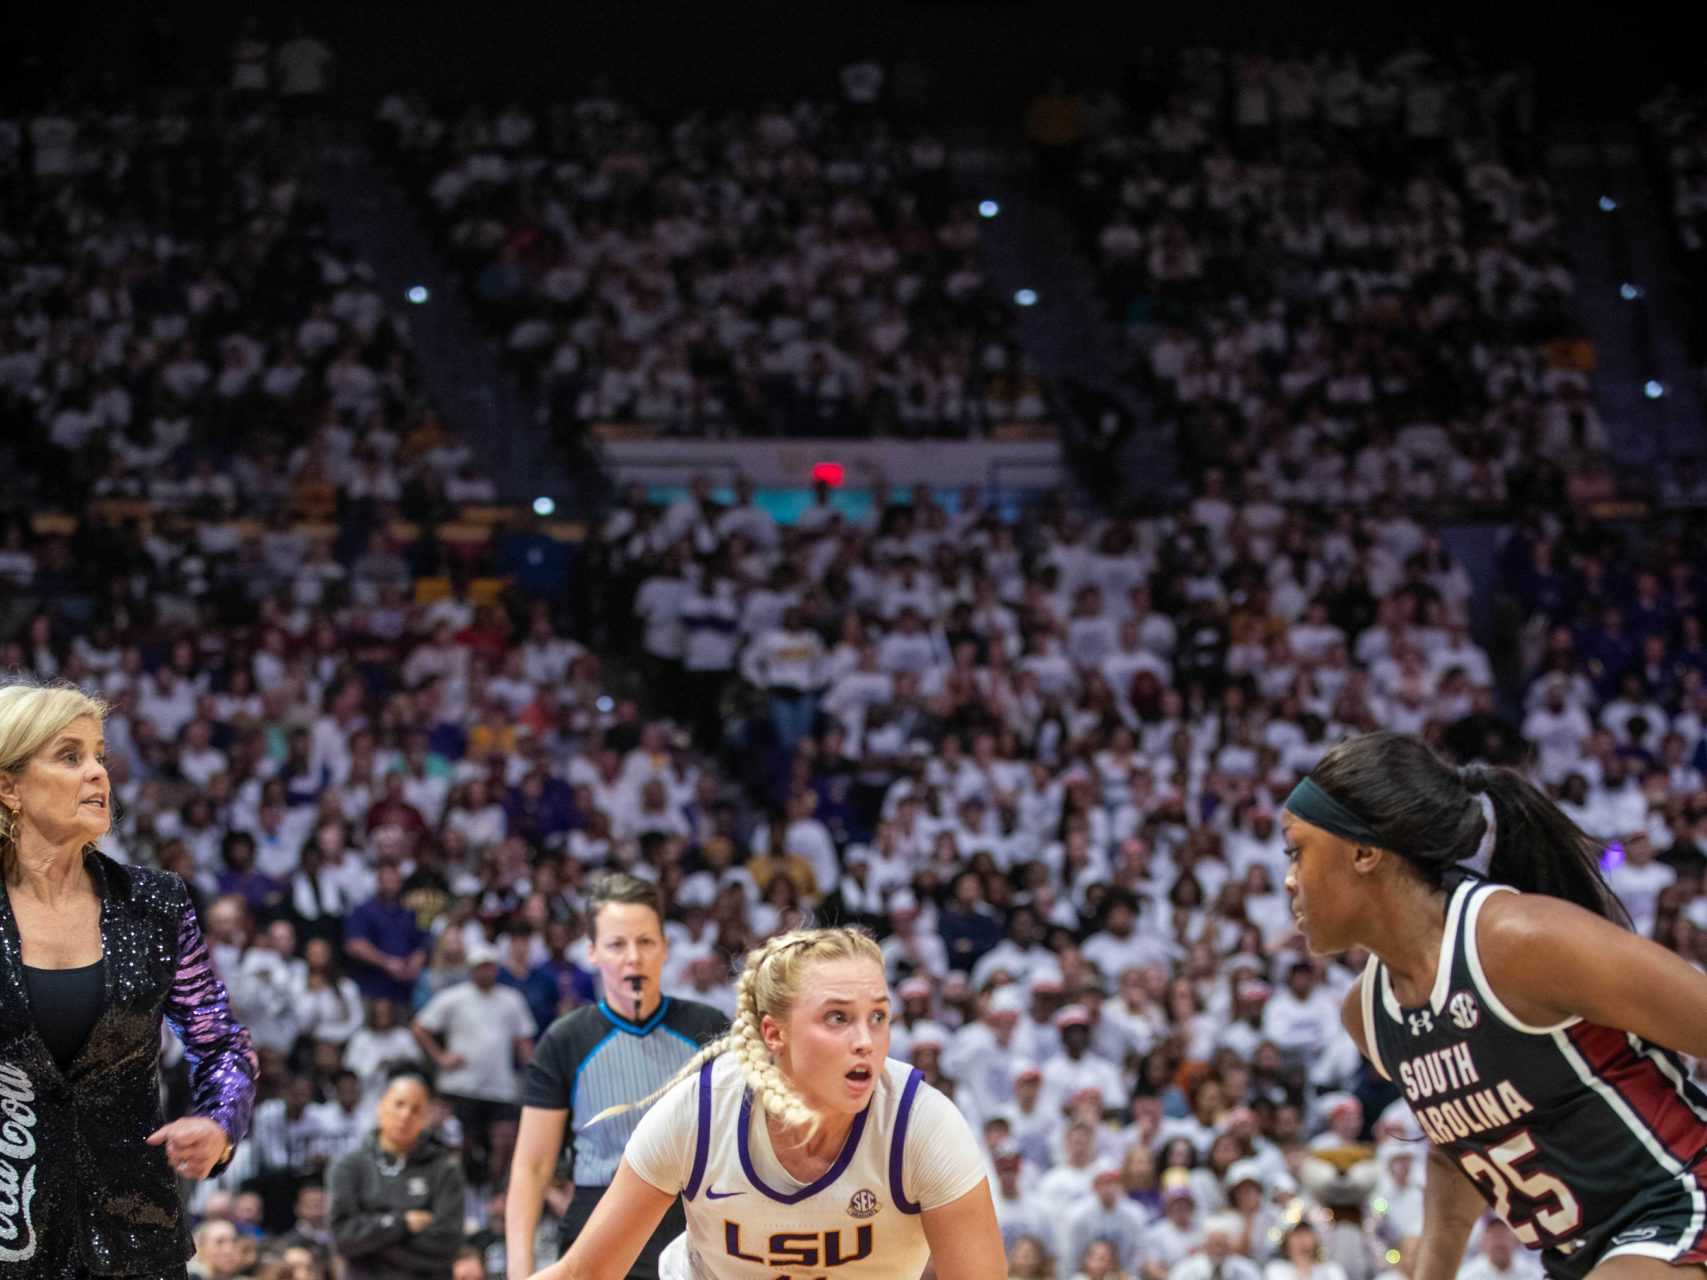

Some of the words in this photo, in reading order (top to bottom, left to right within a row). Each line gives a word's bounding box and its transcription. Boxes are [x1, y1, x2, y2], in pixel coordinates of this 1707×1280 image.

[1399, 1041, 1480, 1102] SOUTH
[1416, 1079, 1535, 1146] AROLINA
[851, 1190, 876, 1212] SEC
[1459, 1130, 1583, 1249] 25
[724, 1220, 873, 1268] LSU
